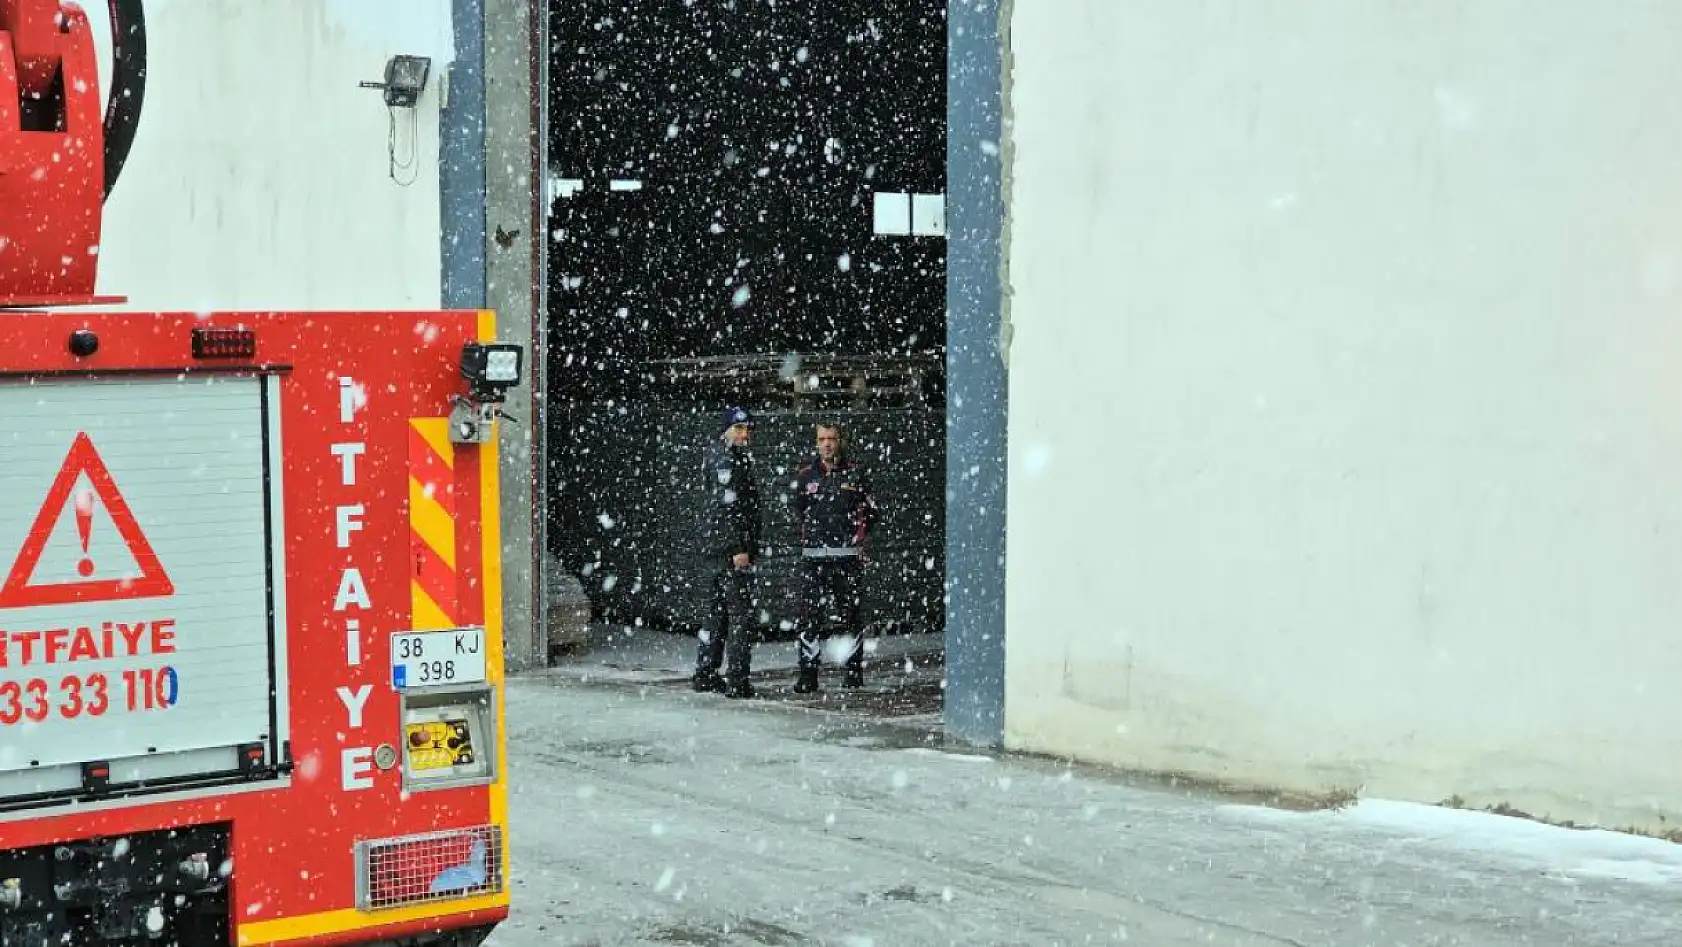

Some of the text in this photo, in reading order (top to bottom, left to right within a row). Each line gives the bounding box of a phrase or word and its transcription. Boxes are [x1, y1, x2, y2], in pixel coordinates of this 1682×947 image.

[331, 376, 373, 791] İTFAİYE
[399, 633, 479, 658] 38 KJ
[419, 660, 455, 682] 398
[0, 665, 179, 725] 33 33 110
